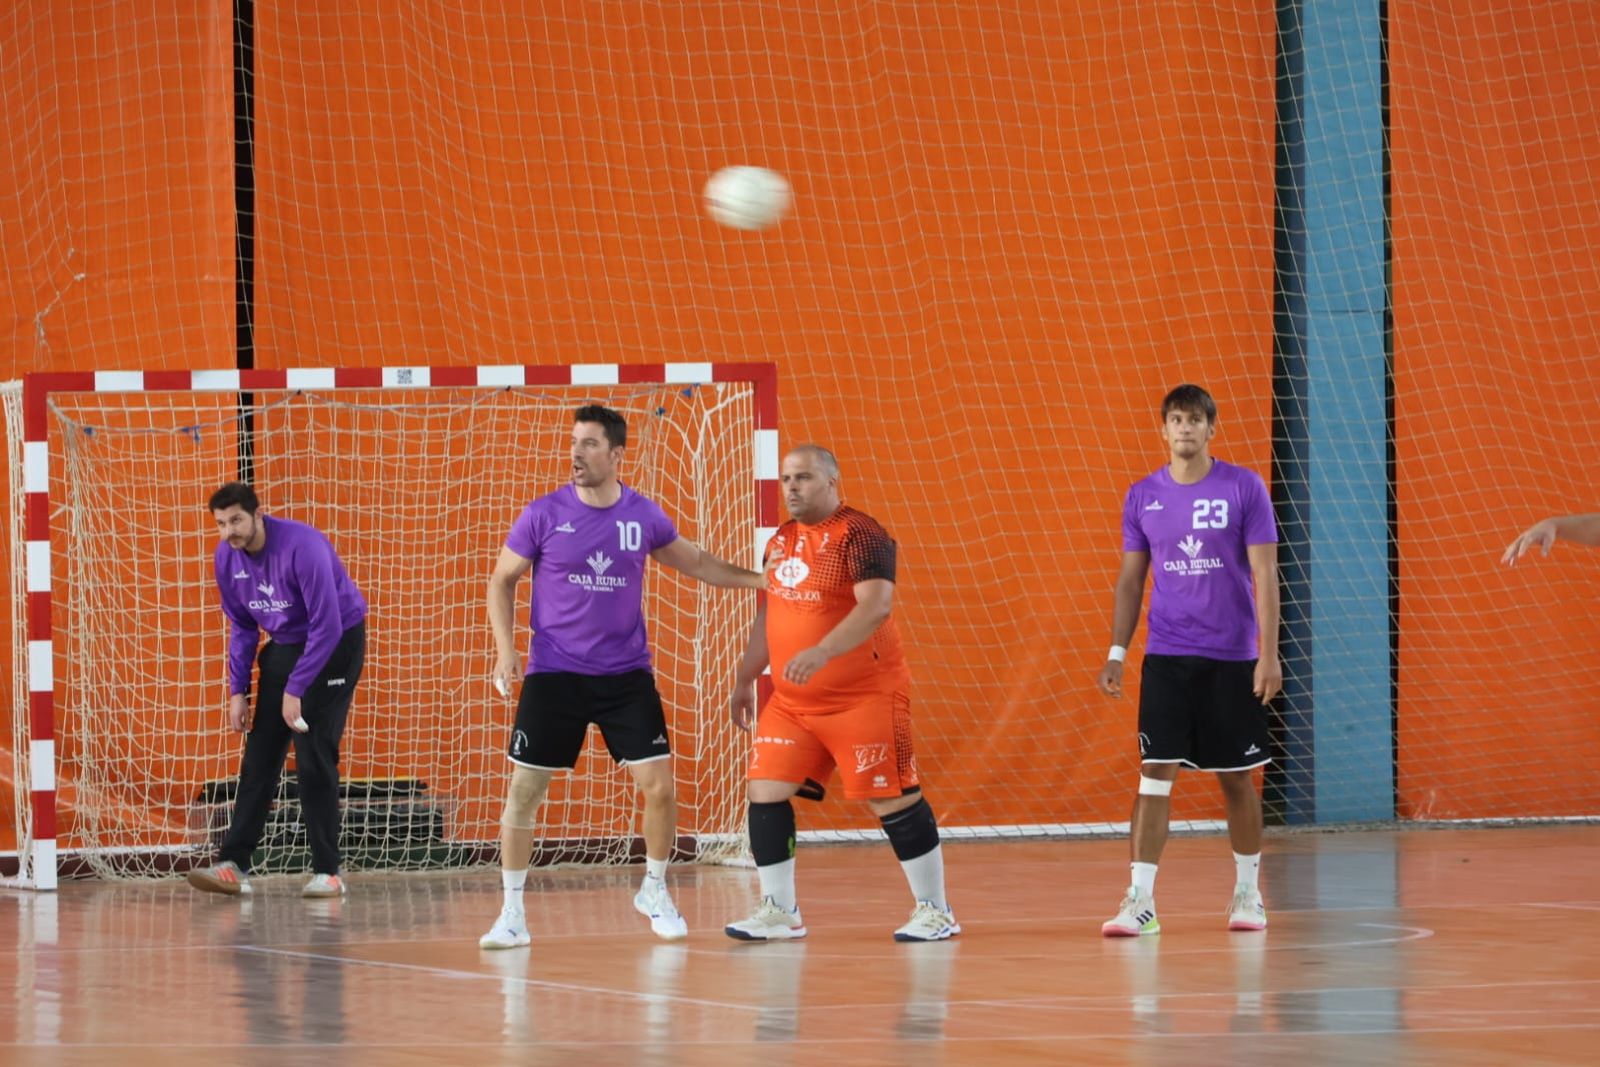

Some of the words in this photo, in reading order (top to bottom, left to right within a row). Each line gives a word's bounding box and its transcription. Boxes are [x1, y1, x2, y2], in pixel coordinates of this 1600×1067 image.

[1192, 498, 1229, 529] 23
[616, 520, 642, 551] 10
[1163, 560, 1188, 571] CAJA
[1190, 558, 1224, 569] RURAL
[568, 574, 593, 585] CAJA
[596, 576, 627, 587] RURAL
